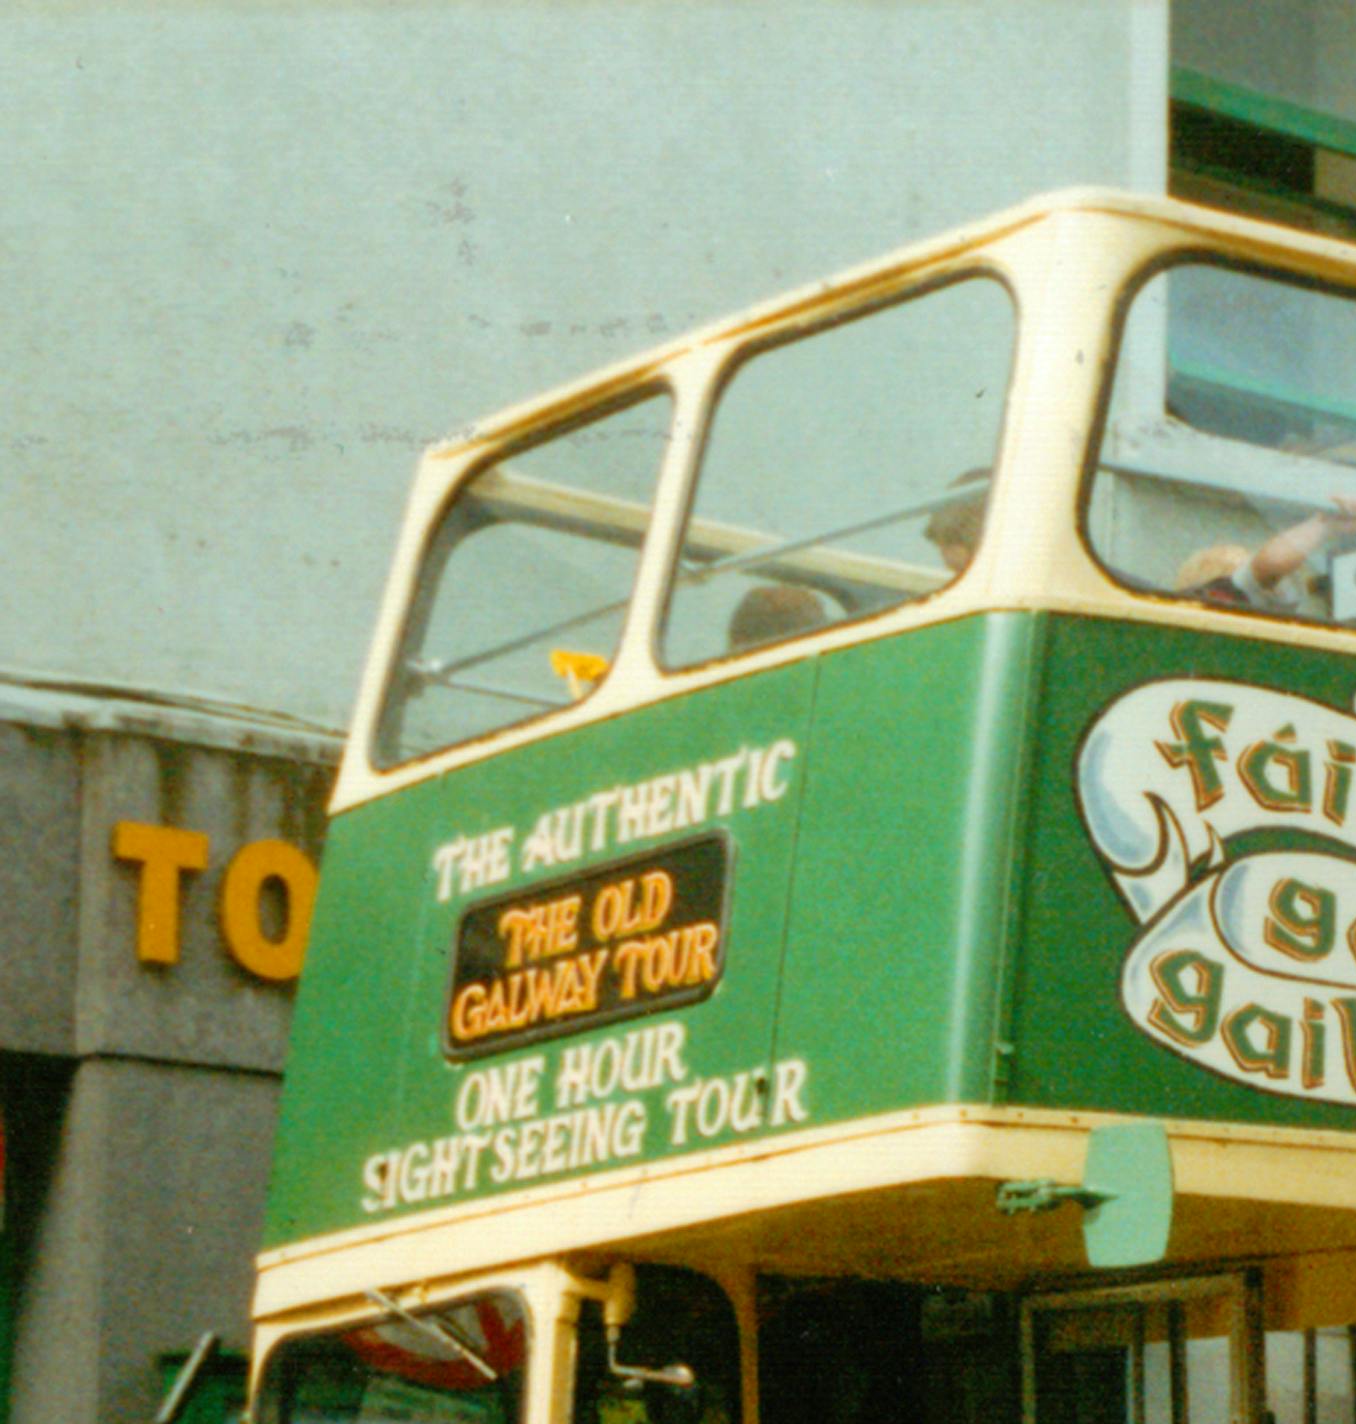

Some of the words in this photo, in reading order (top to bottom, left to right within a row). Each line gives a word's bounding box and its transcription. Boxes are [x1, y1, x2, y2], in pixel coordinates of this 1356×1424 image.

[434, 827, 514, 901] THE
[522, 738, 796, 872] AUTHENTIC
[500, 895, 580, 968] THE
[592, 870, 674, 940] OLD
[450, 948, 609, 1041] GALWAY
[613, 922, 719, 999] TOUR
[362, 1100, 646, 1213] SIGHTSEEING
[666, 1058, 809, 1146] TOUR
[456, 1055, 545, 1131] ONE
[556, 1021, 688, 1108] HOUR
